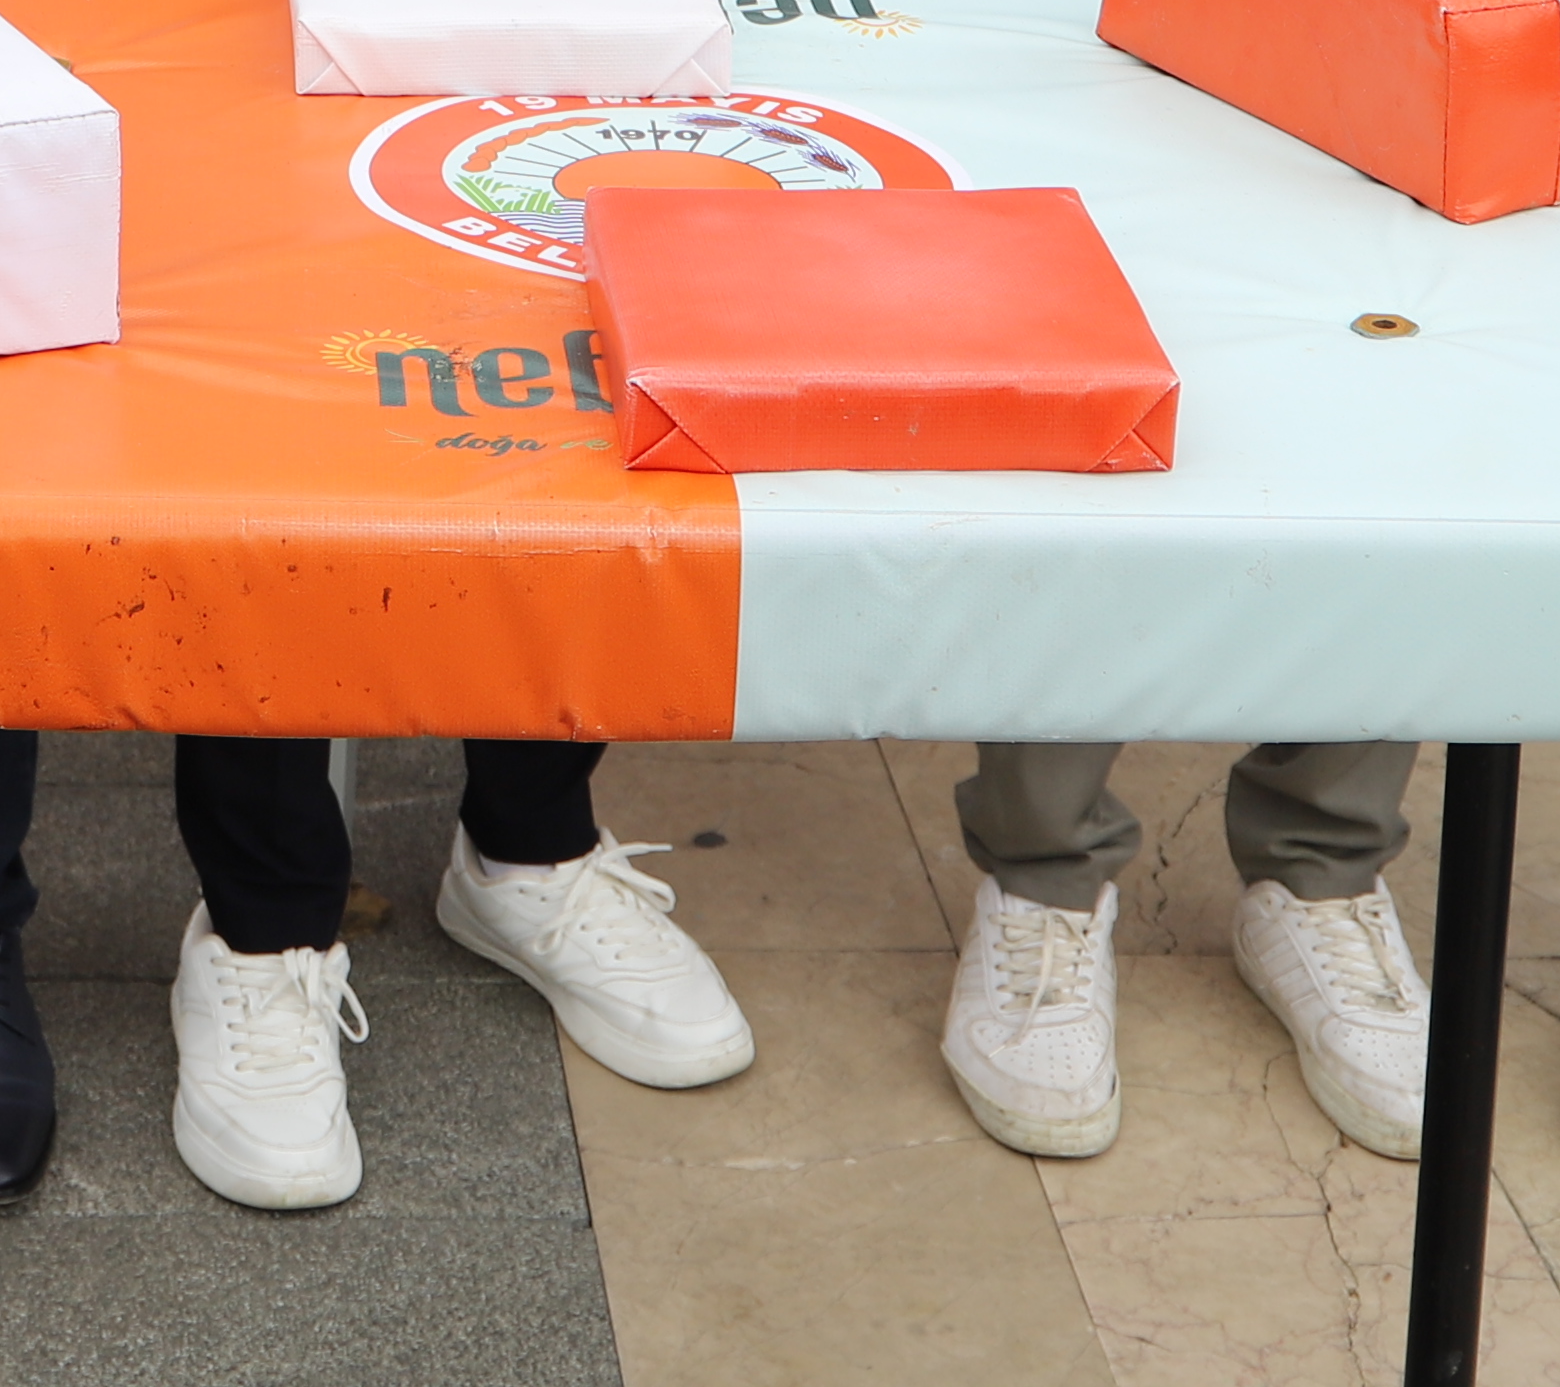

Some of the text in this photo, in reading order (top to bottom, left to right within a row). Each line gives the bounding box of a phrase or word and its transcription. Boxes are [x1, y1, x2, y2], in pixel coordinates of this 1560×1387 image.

[480, 93, 558, 118] 19
[595, 128, 701, 141] 1970
[435, 432, 548, 457] doğa
